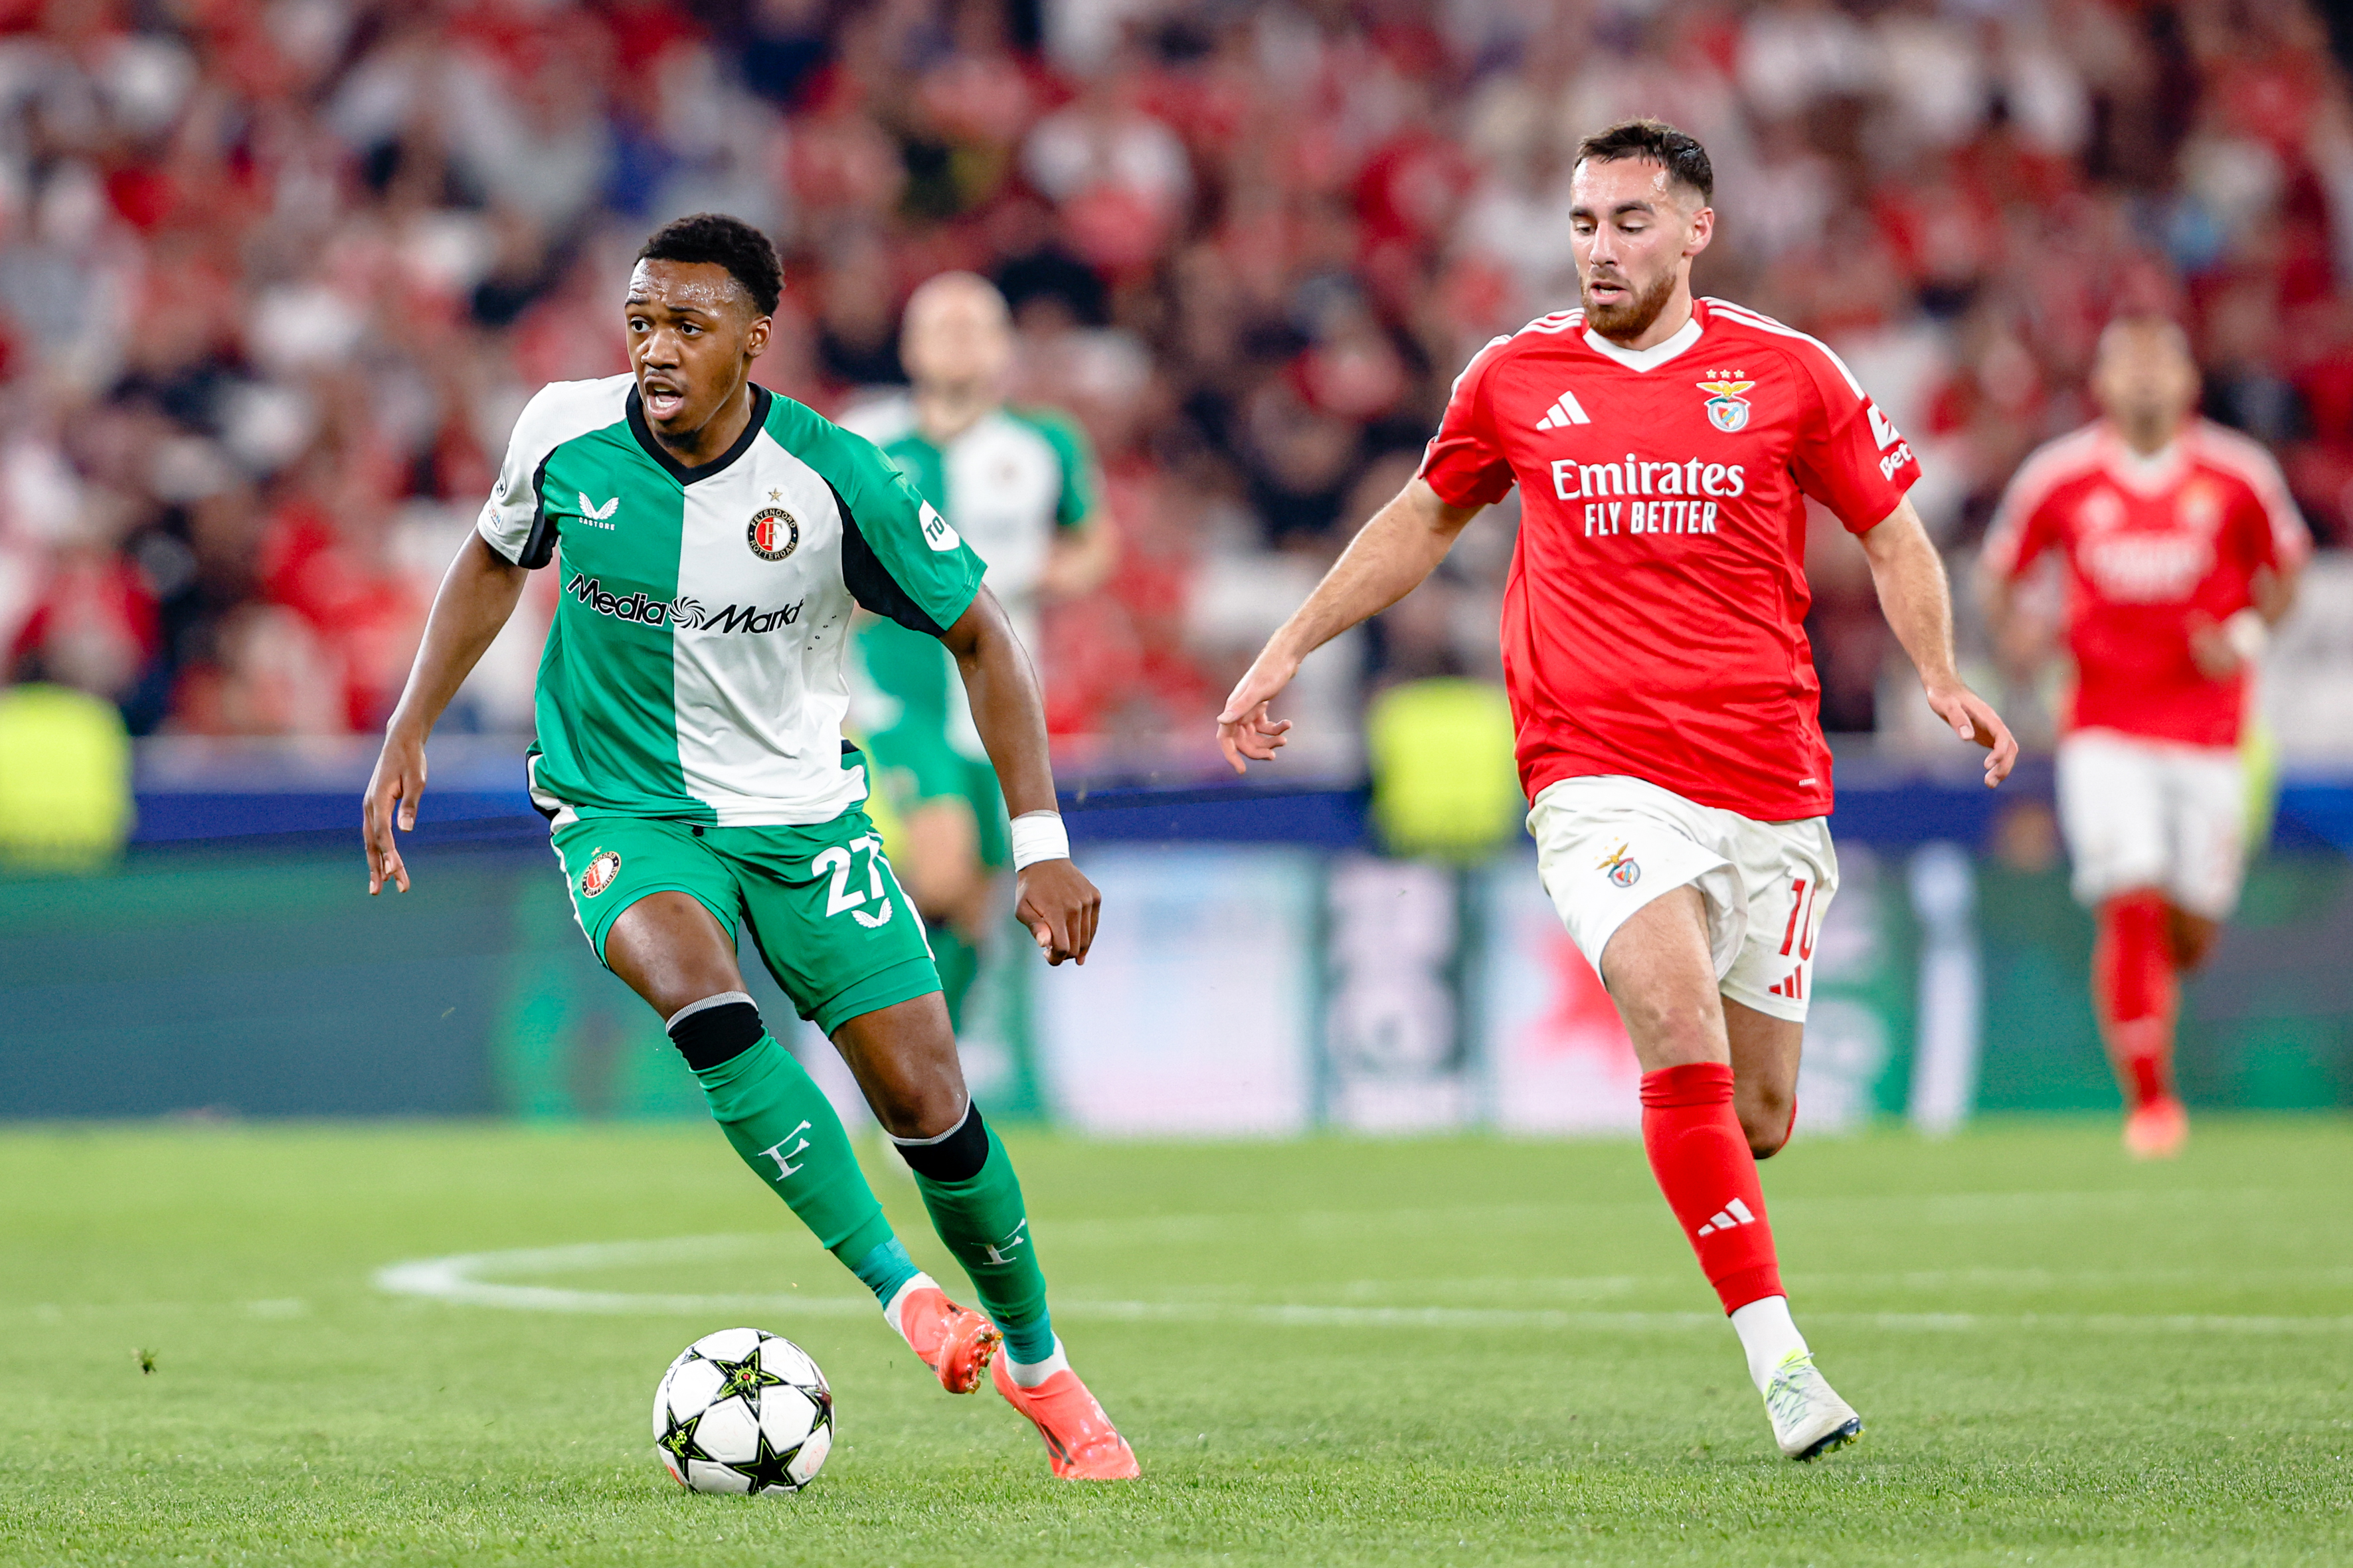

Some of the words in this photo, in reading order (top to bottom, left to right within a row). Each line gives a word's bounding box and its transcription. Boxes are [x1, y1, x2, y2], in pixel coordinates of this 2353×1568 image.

[1551, 453, 1745, 499] Emirates
[578, 516, 616, 531] CASTORE
[750, 509, 796, 528] FEYENOORD
[1585, 501, 1622, 537] FLY
[1630, 500, 1717, 535] BETTER
[749, 539, 796, 559] ROTTERDAM
[566, 572, 669, 627] Media
[699, 598, 804, 634] Markt
[812, 835, 886, 917] 27
[1779, 878, 1816, 960] 10
